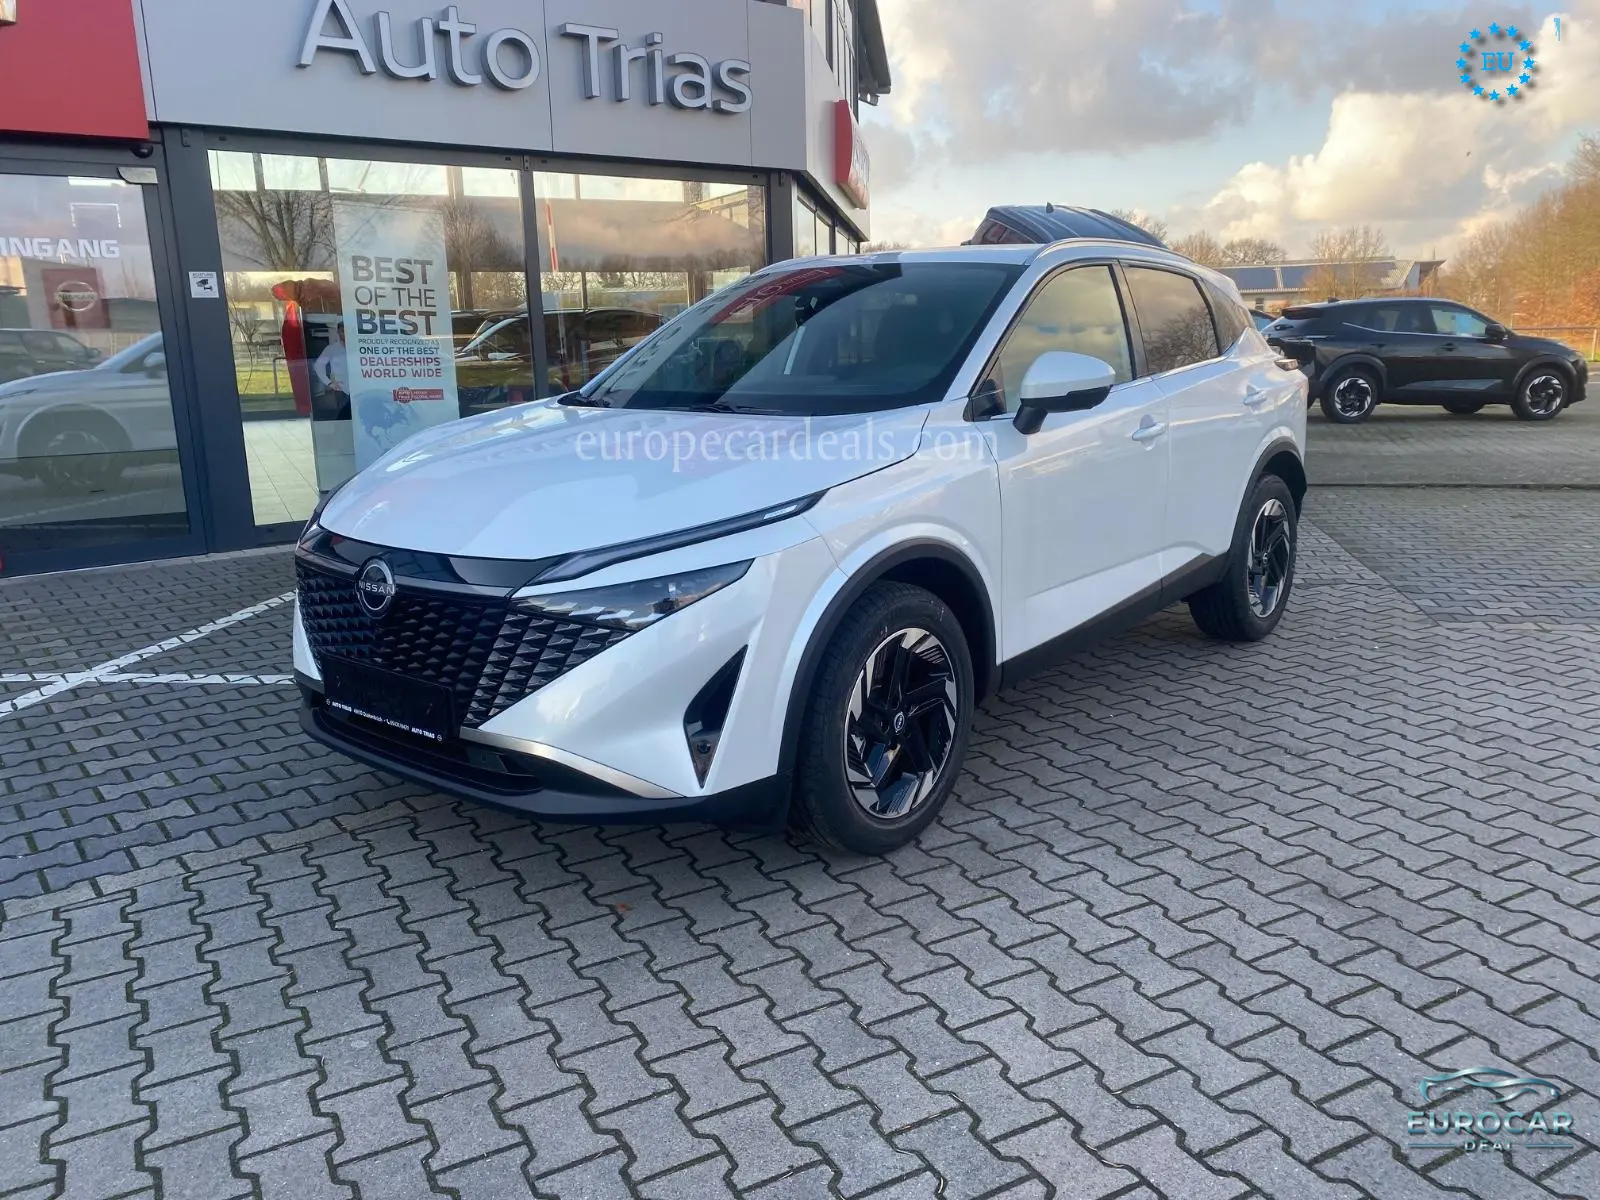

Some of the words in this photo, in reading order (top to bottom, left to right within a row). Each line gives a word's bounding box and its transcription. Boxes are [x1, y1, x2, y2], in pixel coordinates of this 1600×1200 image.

[296, 0, 540, 90] Auto
[559, 22, 753, 114] Trias
[352, 256, 433, 285] BEST
[354, 286, 386, 306] OF
[391, 288, 437, 308] THE
[355, 309, 437, 336] BEST
[359, 346, 380, 354] ONE
[381, 346, 394, 354] OF
[360, 356, 441, 366] DEALERSHIPS
[361, 368, 407, 378] WORLD
[411, 368, 442, 378] WIDE
[359, 580, 395, 595] NISSAN
